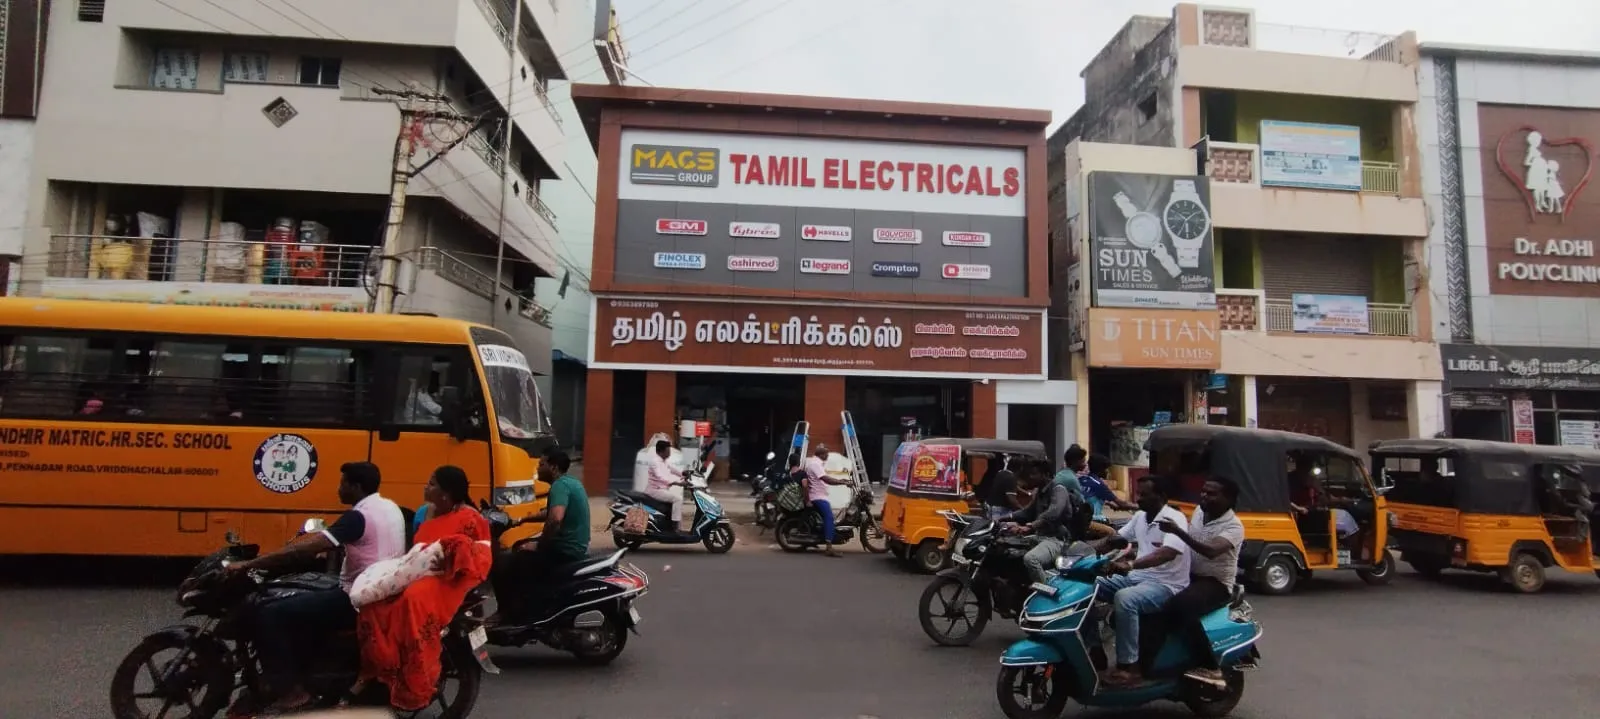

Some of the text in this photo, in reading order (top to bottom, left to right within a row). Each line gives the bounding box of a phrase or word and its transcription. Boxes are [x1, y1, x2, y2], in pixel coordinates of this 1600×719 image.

[677, 172, 713, 184] GROUP
[729, 153, 1020, 197] TAMIL ELECTRICALS
[669, 221, 699, 231] GM
[818, 229, 849, 237] HAVELLS
[1514, 237, 1594, 257] Dr. ADHI
[658, 253, 702, 263] FINOLEX
[731, 258, 776, 269] ashirvad
[1099, 248, 1149, 268] SUN
[812, 259, 849, 272] legrand
[872, 263, 919, 275] Crompton
[1099, 268, 1153, 282] TIMES
[611, 311, 903, 351] தமிழ் எலக்ட்ரிக்கல்ஸ்
[1131, 317, 1217, 342] TITAN
[1142, 346, 1214, 359] SUN TIMES
[1507, 357, 1540, 376] ஆதி
[173, 432, 232, 450] SCHOOL
[256, 471, 310, 492] SCHOOL BUS
